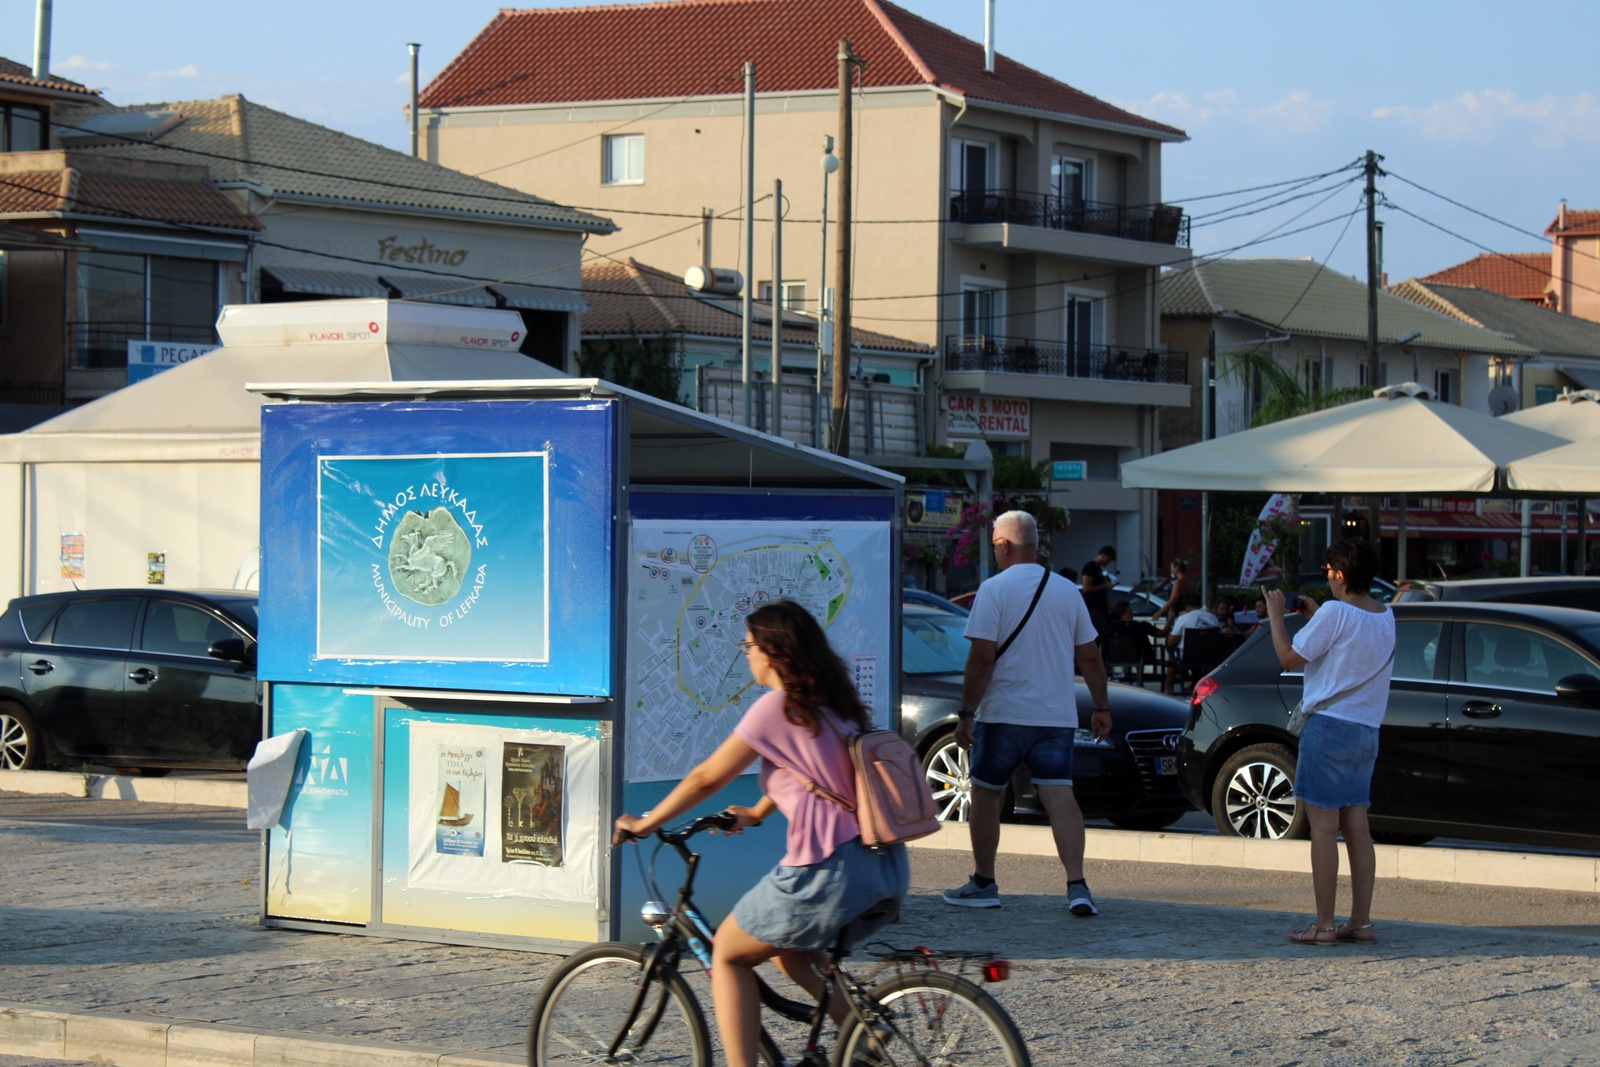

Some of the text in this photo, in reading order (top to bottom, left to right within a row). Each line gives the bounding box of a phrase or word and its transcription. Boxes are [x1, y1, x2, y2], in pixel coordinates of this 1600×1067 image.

[377, 235, 468, 267] Festino
[309, 332, 371, 341] FLAVOR SPOT
[459, 336, 510, 347] FLAVOR SPOT
[161, 347, 212, 363] PEGA
[948, 396, 1028, 416] CAR & MOTO
[980, 415, 1028, 433] RENTAL
[371, 483, 488, 549] ΔΗΜΟΣ ΛΕΥΚΑΔΑΣ
[371, 563, 487, 629] MUNICIPALITY OF LEFKADA
